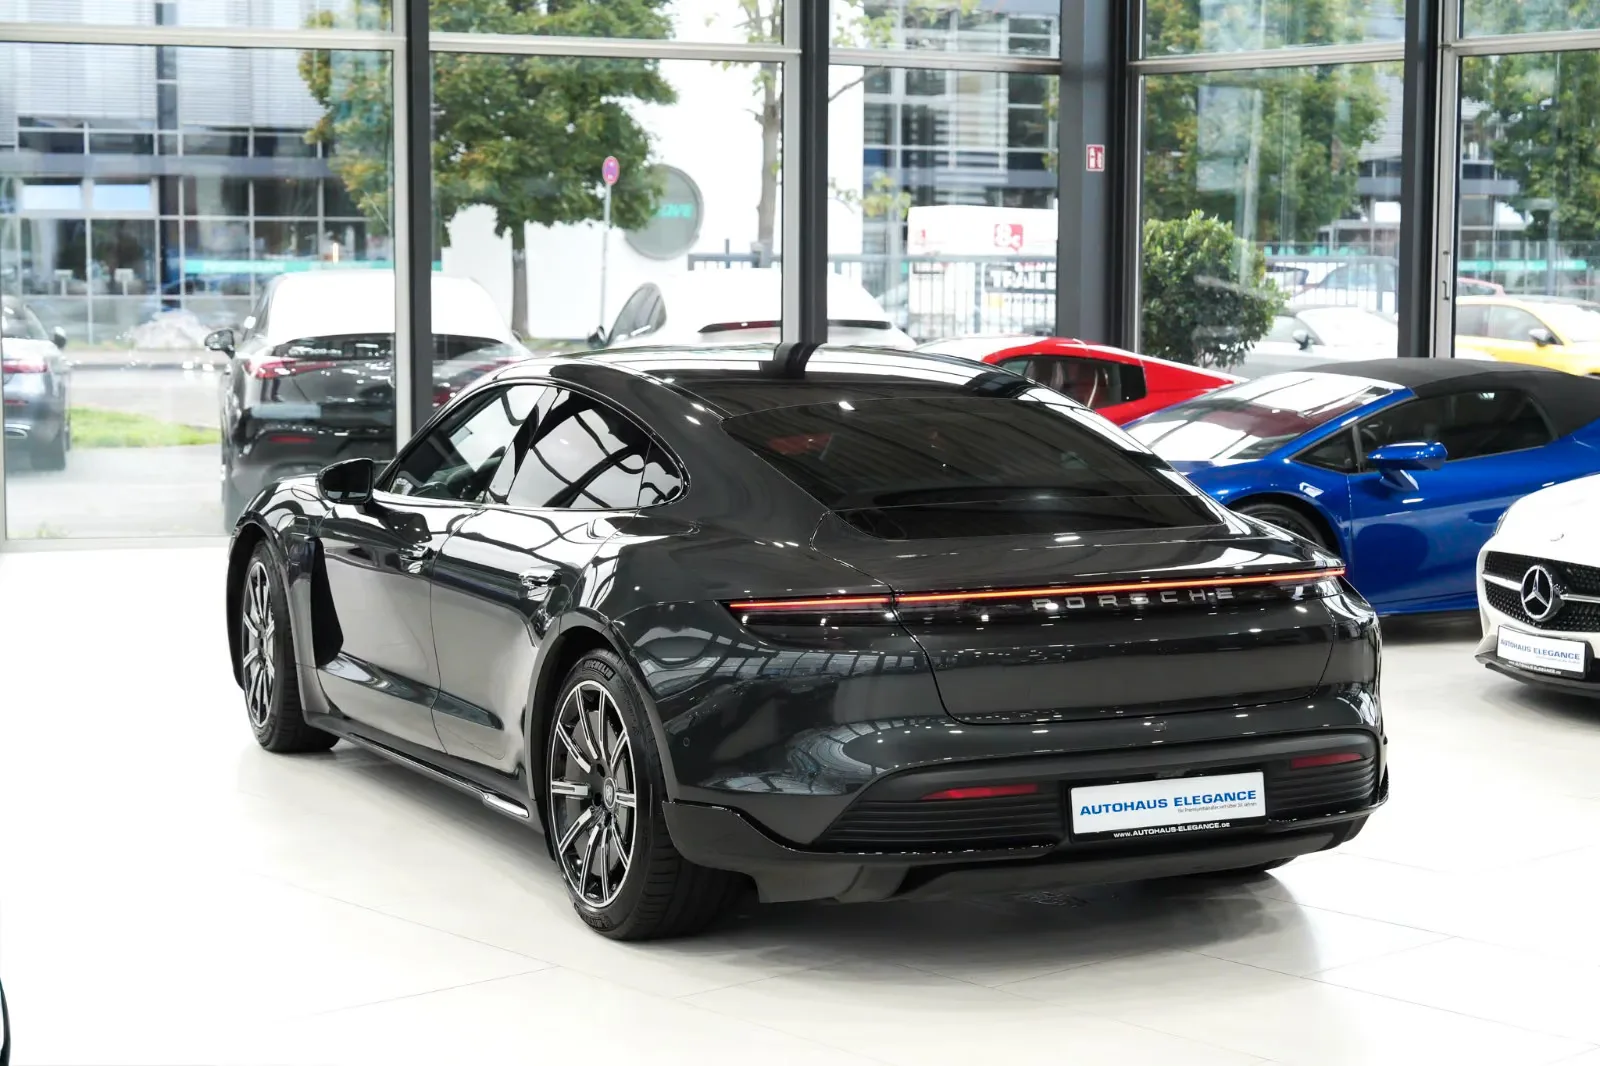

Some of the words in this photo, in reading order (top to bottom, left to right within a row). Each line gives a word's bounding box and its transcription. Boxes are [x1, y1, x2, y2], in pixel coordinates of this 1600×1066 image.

[1032, 587, 1234, 611] PORSCHE
[1500, 638, 1532, 653] AUTOHAUS
[1533, 647, 1581, 661] ELEGANCE
[1080, 798, 1168, 816] AUTOHAUS
[1174, 790, 1257, 807] ELEGANCE
